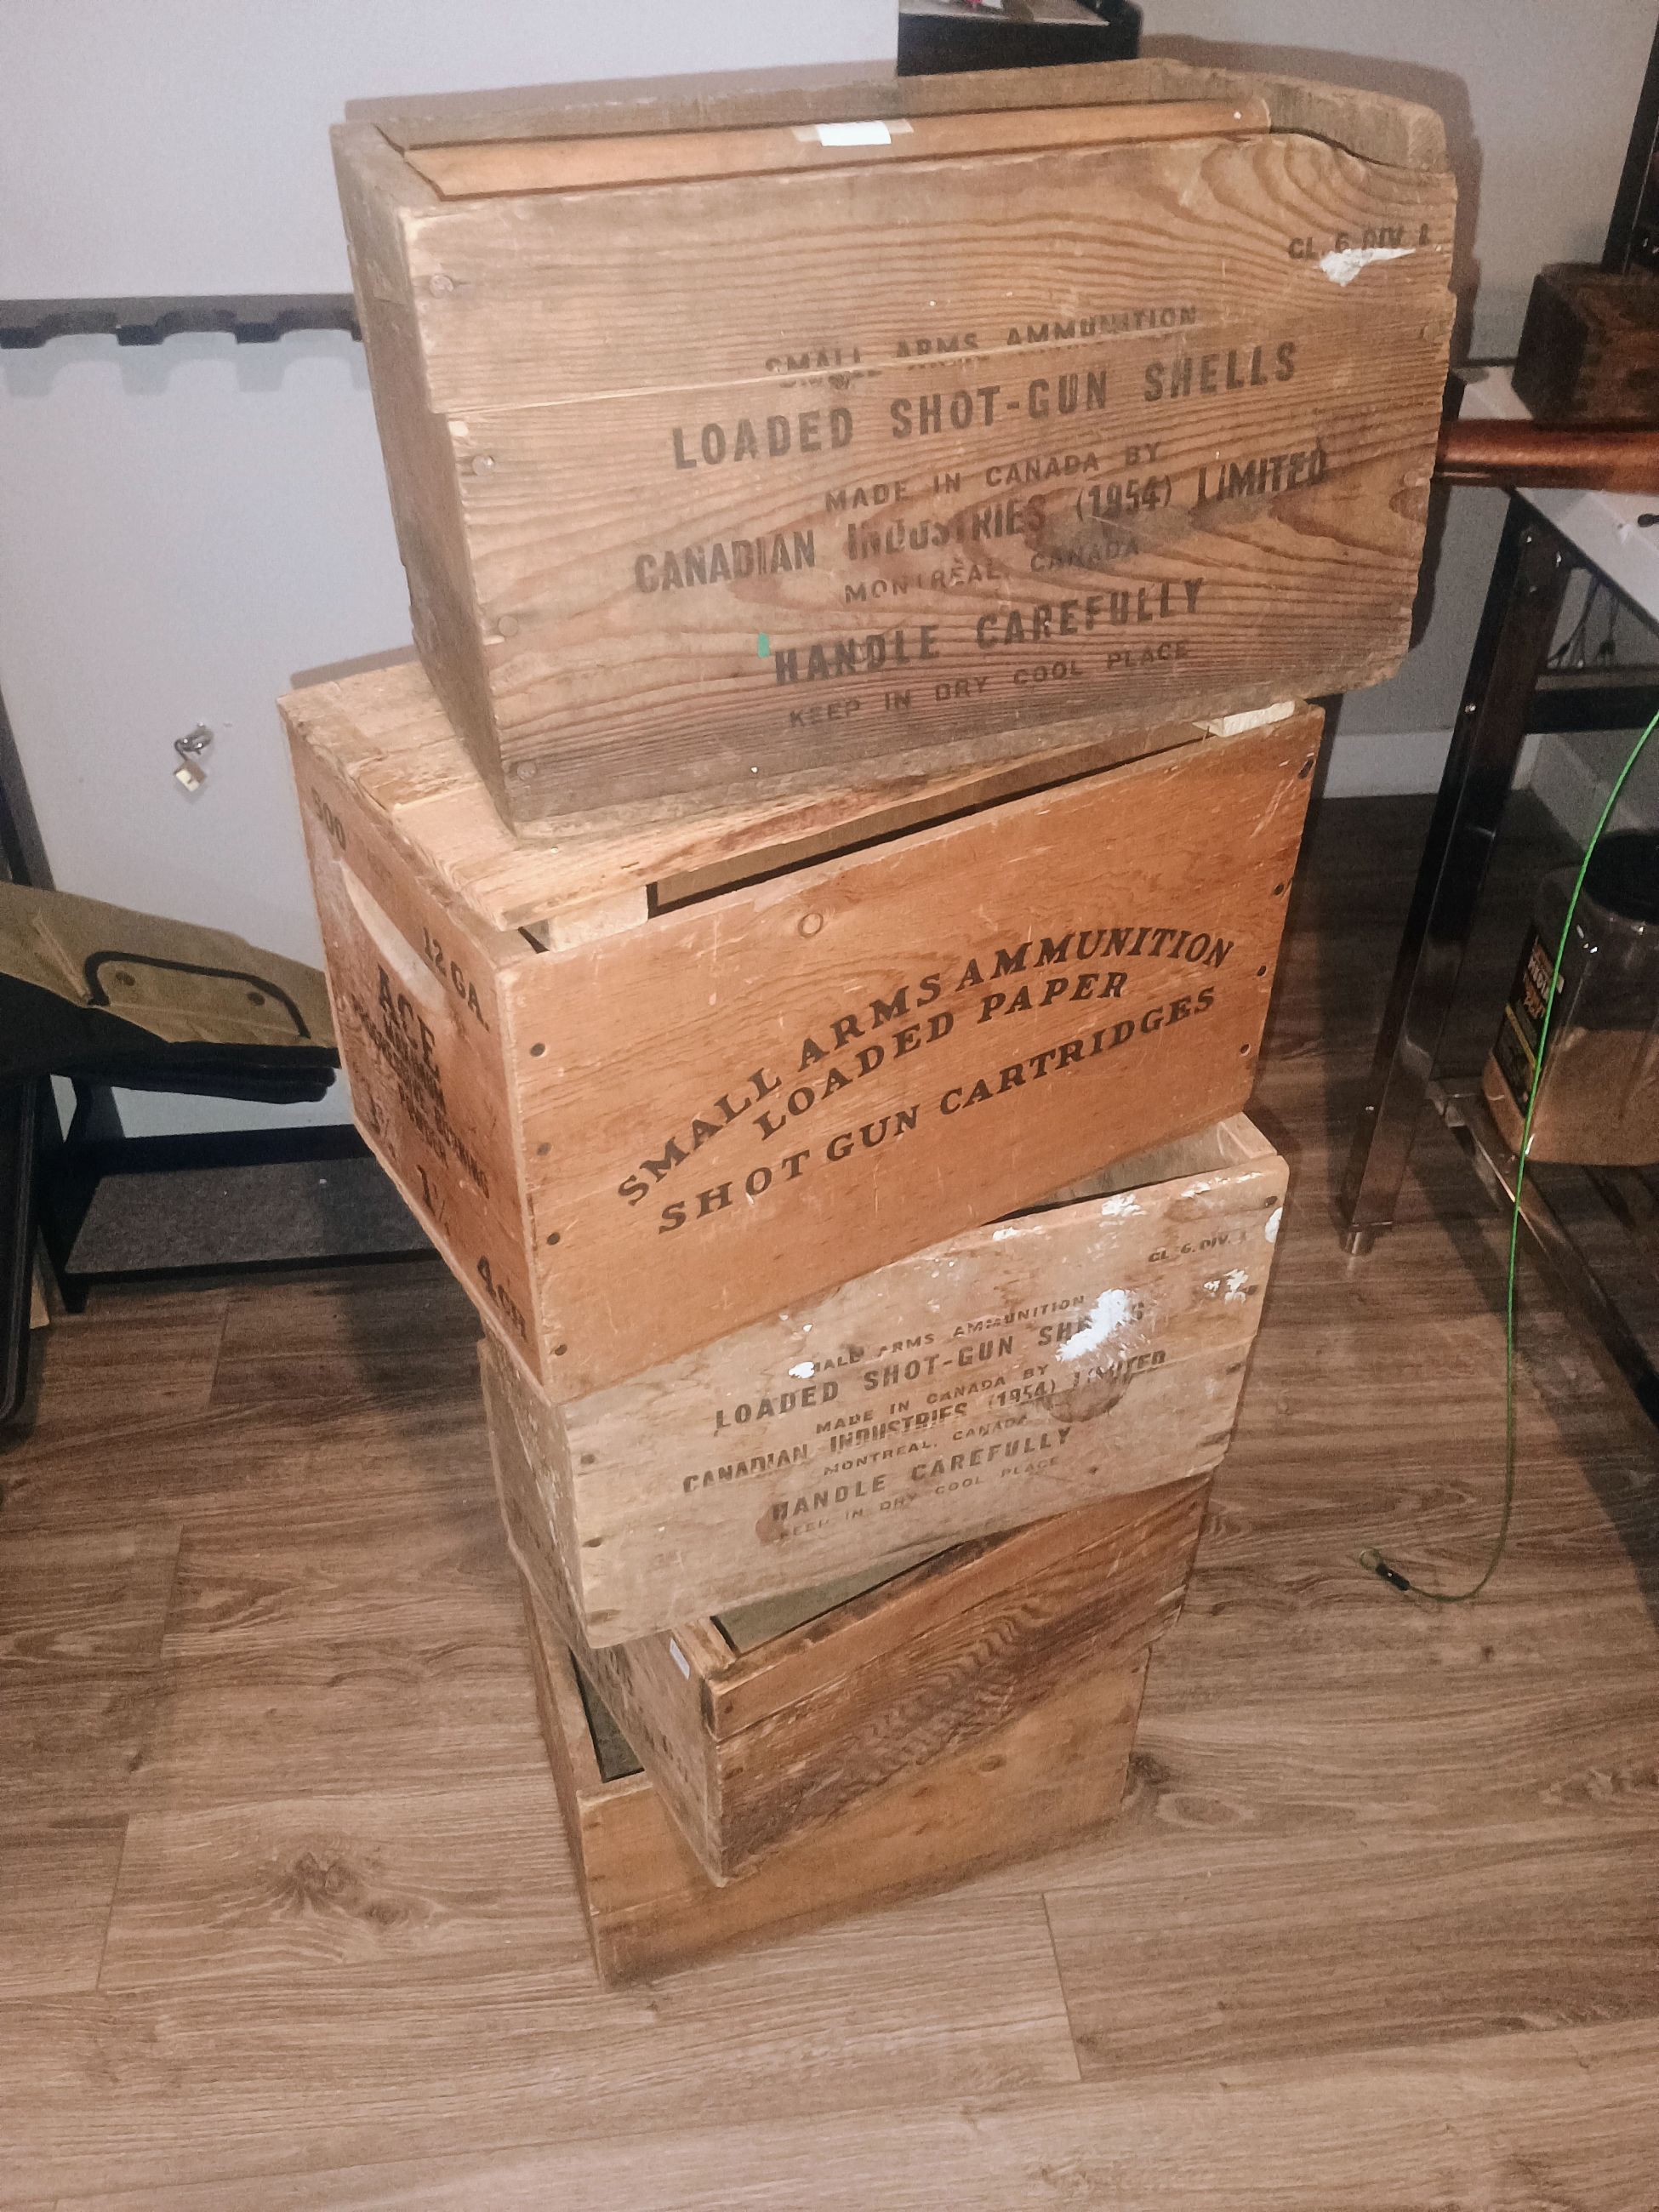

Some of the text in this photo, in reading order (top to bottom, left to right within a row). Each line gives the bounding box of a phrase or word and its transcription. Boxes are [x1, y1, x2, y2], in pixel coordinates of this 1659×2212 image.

[896, 331, 989, 370] ARMS
[1006, 305, 1197, 352] AMMUNITION
[673, 341, 1295, 470] LOADED SHOT-GUN SHELLS
[634, 444, 1329, 594] CANADIAN INDUSTRIES (1954) LIMITED
[824, 442, 1161, 511] MADE IN CANADA BY
[1029, 534, 1140, 572] CANADA
[775, 577, 1204, 685] HANDLE CAREFULLY
[790, 640, 1191, 729] KEEP IN DRY COOL PLACE
[422, 926, 447, 977] 12
[379, 963, 441, 1080] ACE
[618, 926, 1234, 1206] SMALL ARMS AMMUNITION
[752, 972, 1129, 1141] LOADED PAPER
[658, 987, 1216, 1234] SHOT GUN CARTRIDGES
[715, 1301, 1146, 1429] LOADED SHOT-GUN SHES
[877, 1333, 935, 1359] ARMS
[952, 1295, 1085, 1338] AMMUNITION
[683, 1443, 807, 1494] CANADIAN
[830, 1401, 968, 1453] INDUSTRIES
[988, 1378, 1057, 1411] (1954)
[816, 1364, 1049, 1434] MADE IN CANADA BY
[952, 1415, 1029, 1441] CANADA
[772, 1427, 1071, 1521] HANDLE CAREFULLY
[845, 1508, 864, 1520] IN
[879, 1492, 918, 1511] DRY
[935, 1478, 982, 1496] COOL
[1000, 1456, 1060, 1479] PLACE
